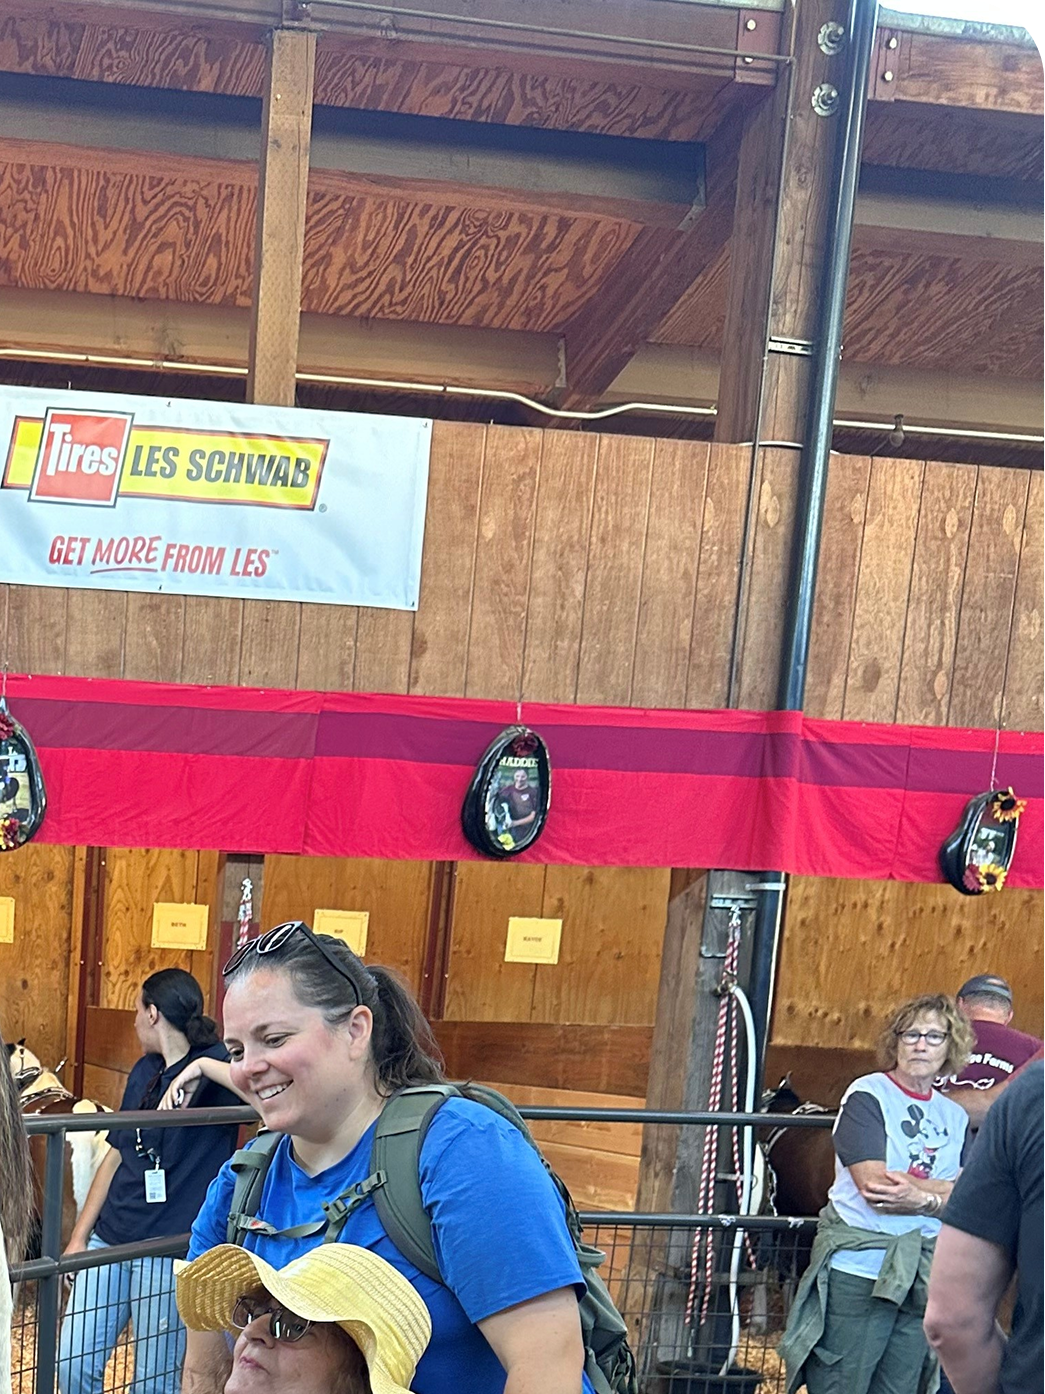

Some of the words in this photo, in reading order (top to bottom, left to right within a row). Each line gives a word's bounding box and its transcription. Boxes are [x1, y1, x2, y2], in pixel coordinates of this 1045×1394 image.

[45, 422, 119, 476] Tires
[129, 444, 180, 479] LES
[185, 448, 312, 489] SCHWAB
[48, 535, 91, 566] GET
[91, 535, 162, 566] MORE
[160, 543, 227, 576] FROM
[229, 548, 271, 578] LES
[982, 1053, 1014, 1074] Farms
